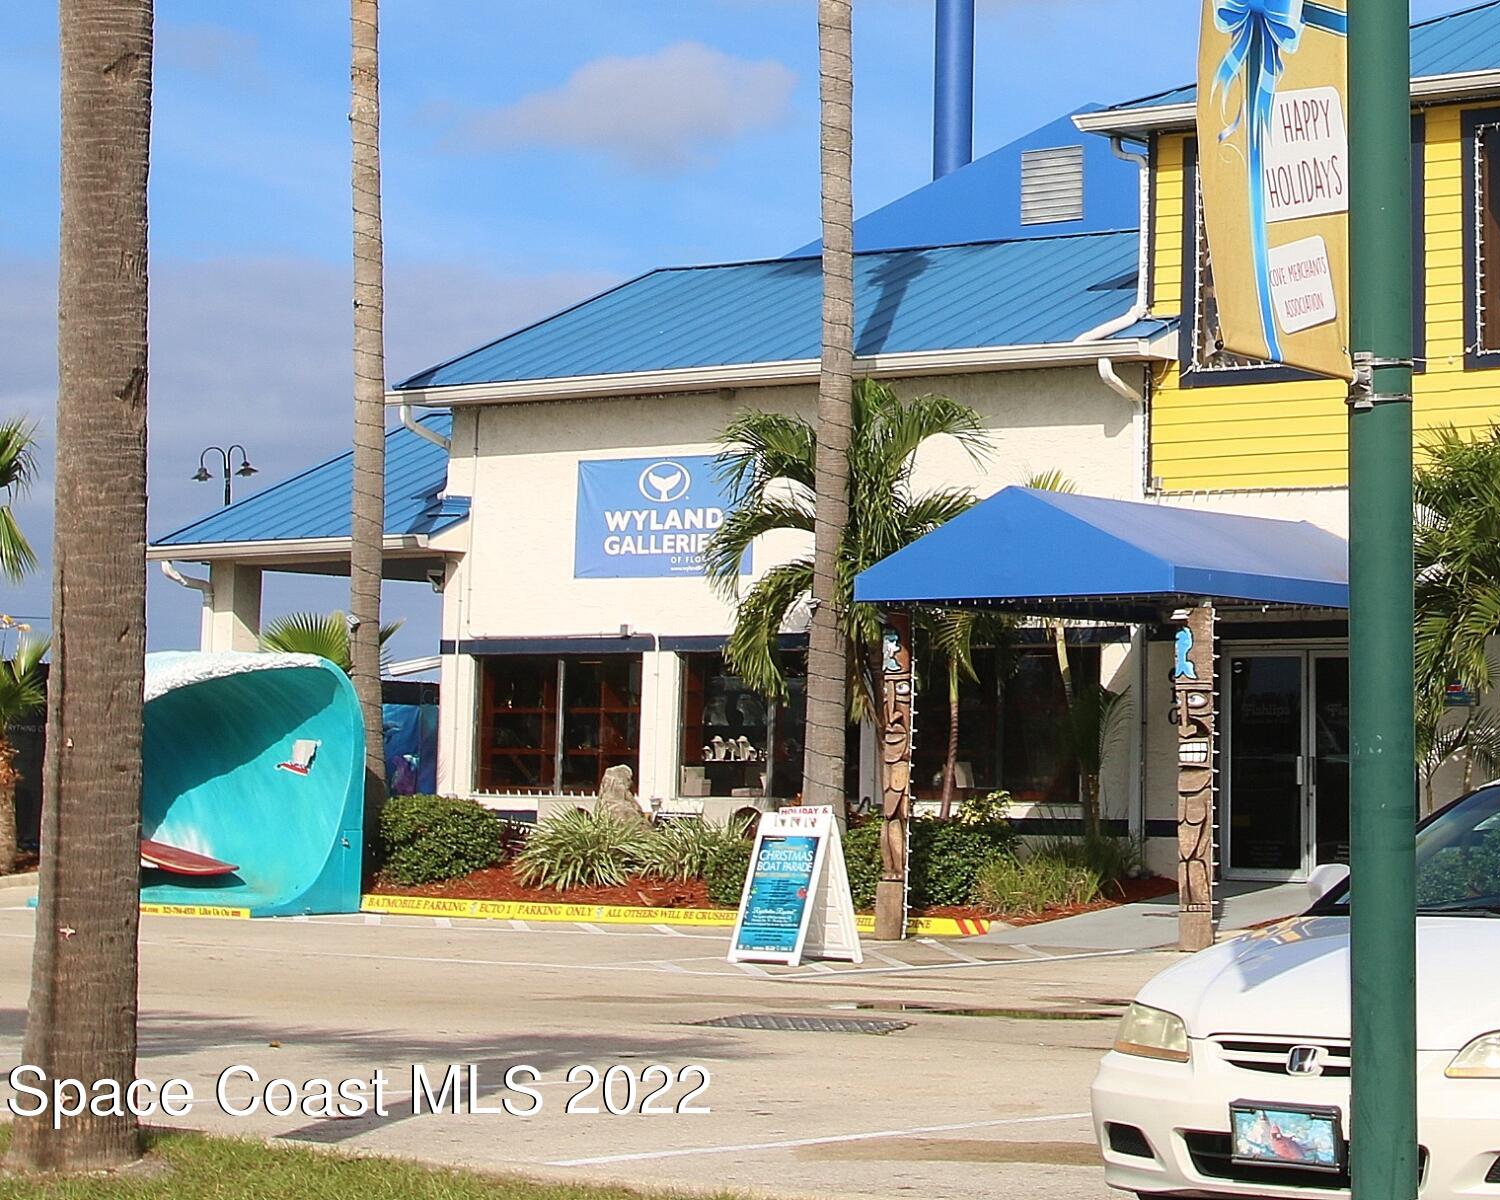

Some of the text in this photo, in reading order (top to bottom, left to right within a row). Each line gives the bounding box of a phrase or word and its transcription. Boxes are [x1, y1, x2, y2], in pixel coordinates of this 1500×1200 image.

[1280, 99, 1330, 143] HAPPY
[1266, 155, 1343, 209] HOLIDAYS
[1270, 257, 1327, 287] COVE MERCHANTS
[1284, 293, 1325, 318] ASSOCIATION
[604, 508, 724, 532] WYLAND
[604, 534, 713, 555] GALLERIE
[759, 849, 814, 862] CHRISTMAS
[756, 861, 813, 873] BOAT PARADE
[368, 898, 467, 913] BATMOBILE PARKING
[516, 904, 562, 916] PARKING
[565, 907, 593, 917] ONLY
[607, 908, 621, 918] ALL
[623, 909, 659, 918] OTHERS
[660, 910, 682, 919] WILL
[683, 911, 694, 920] BE
